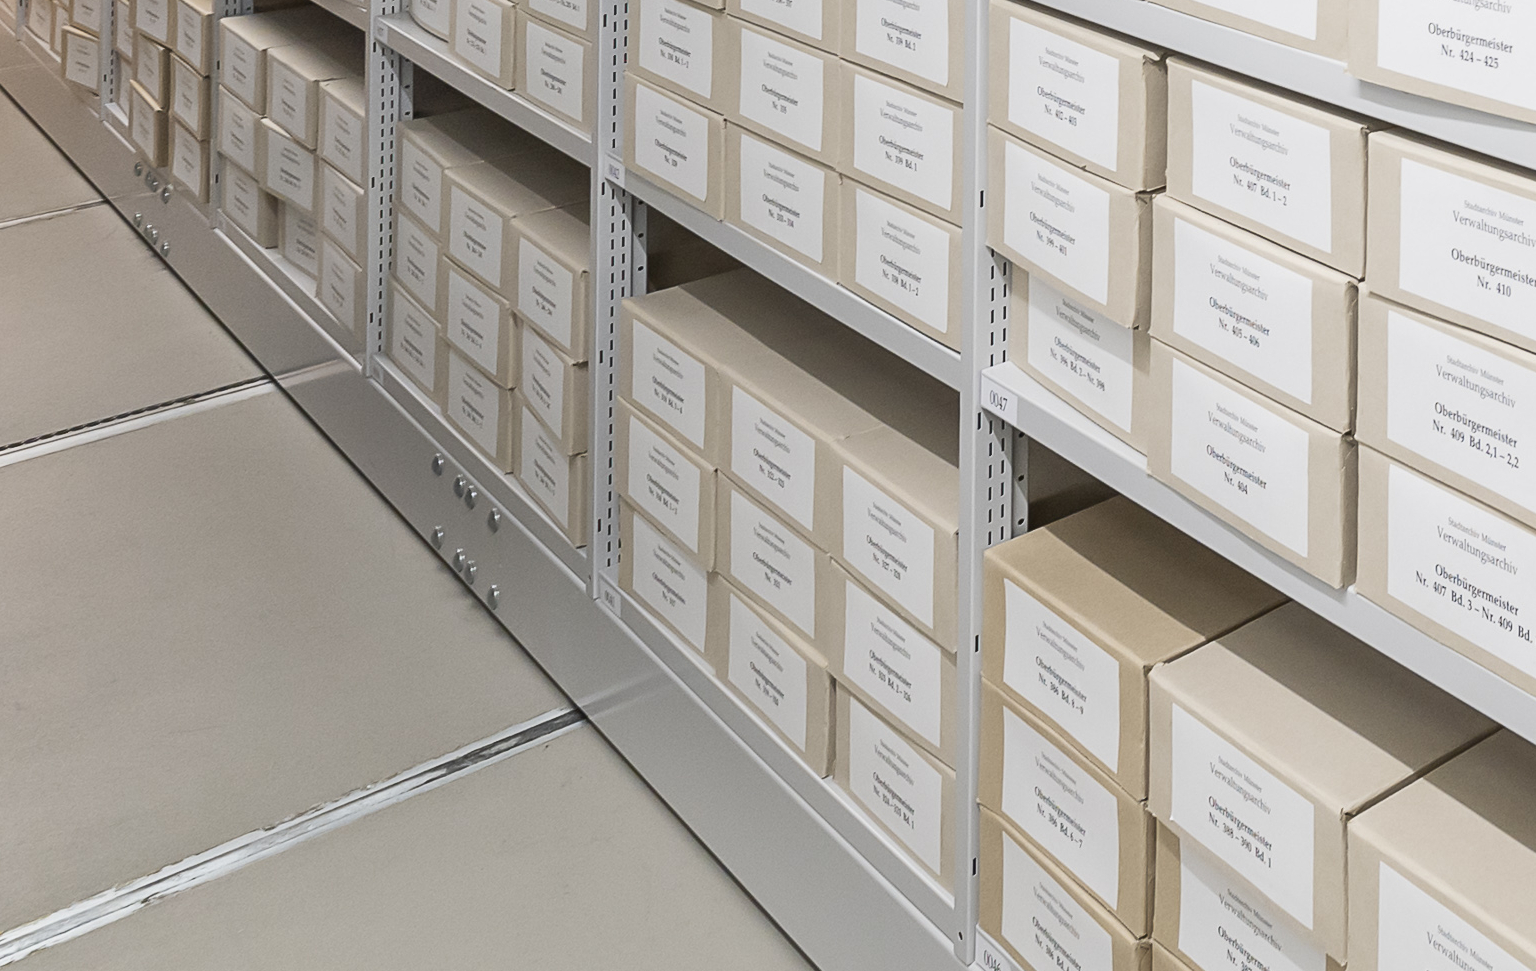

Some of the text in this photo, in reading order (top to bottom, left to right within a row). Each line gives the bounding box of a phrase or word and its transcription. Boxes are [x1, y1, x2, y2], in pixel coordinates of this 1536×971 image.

[1427, 22, 1512, 53] Oberbürgermeister
[1441, 43, 1498, 68] Nr. 424 425
[1229, 122, 1288, 155] Verwaltungsarchiv
[1229, 156, 1290, 190] Oberbürgermeister
[1452, 209, 1536, 247] Verwaltungsarchiv
[1498, 210, 1524, 226] Münster
[1209, 262, 1268, 300] Verwaltungsarchiv
[1451, 247, 1536, 287] Oberbürgermeister
[1477, 274, 1511, 297] Nr. 410
[1209, 296, 1269, 336] Oberbürgermeister
[1435, 363, 1515, 408] Verwaltungsarchiv
[1479, 368, 1504, 385] Münster
[990, 390, 1008, 412] 0047
[1207, 410, 1265, 452] Verwaltungsarchiv
[1432, 419, 1518, 468] Nr. 409 Bd. 2,1 2,2
[1434, 401, 1517, 447] Oberbürgermeister
[1206, 444, 1266, 489] Oberbürgermeister
[1437, 525, 1517, 575] Verwaltungsarchiv
[1481, 532, 1506, 551] Münster
[1416, 570, 1428, 587] Nr.
[1433, 581, 1446, 596] 407
[1451, 589, 1465, 607] Bd.
[1467, 599, 1472, 610] 3
[1482, 606, 1495, 623] Nr.
[1497, 615, 1512, 631] 409
[1517, 625, 1532, 643] Bd.
[1435, 563, 1518, 615] Oberbürgermeister
[1035, 655, 1086, 702] Oberbürgermeister
[1209, 761, 1271, 814] Verwaltungsarchiv
[1034, 786, 1085, 836] Oberbürgermeister
[1208, 795, 1271, 851] Oberbürgermeister
